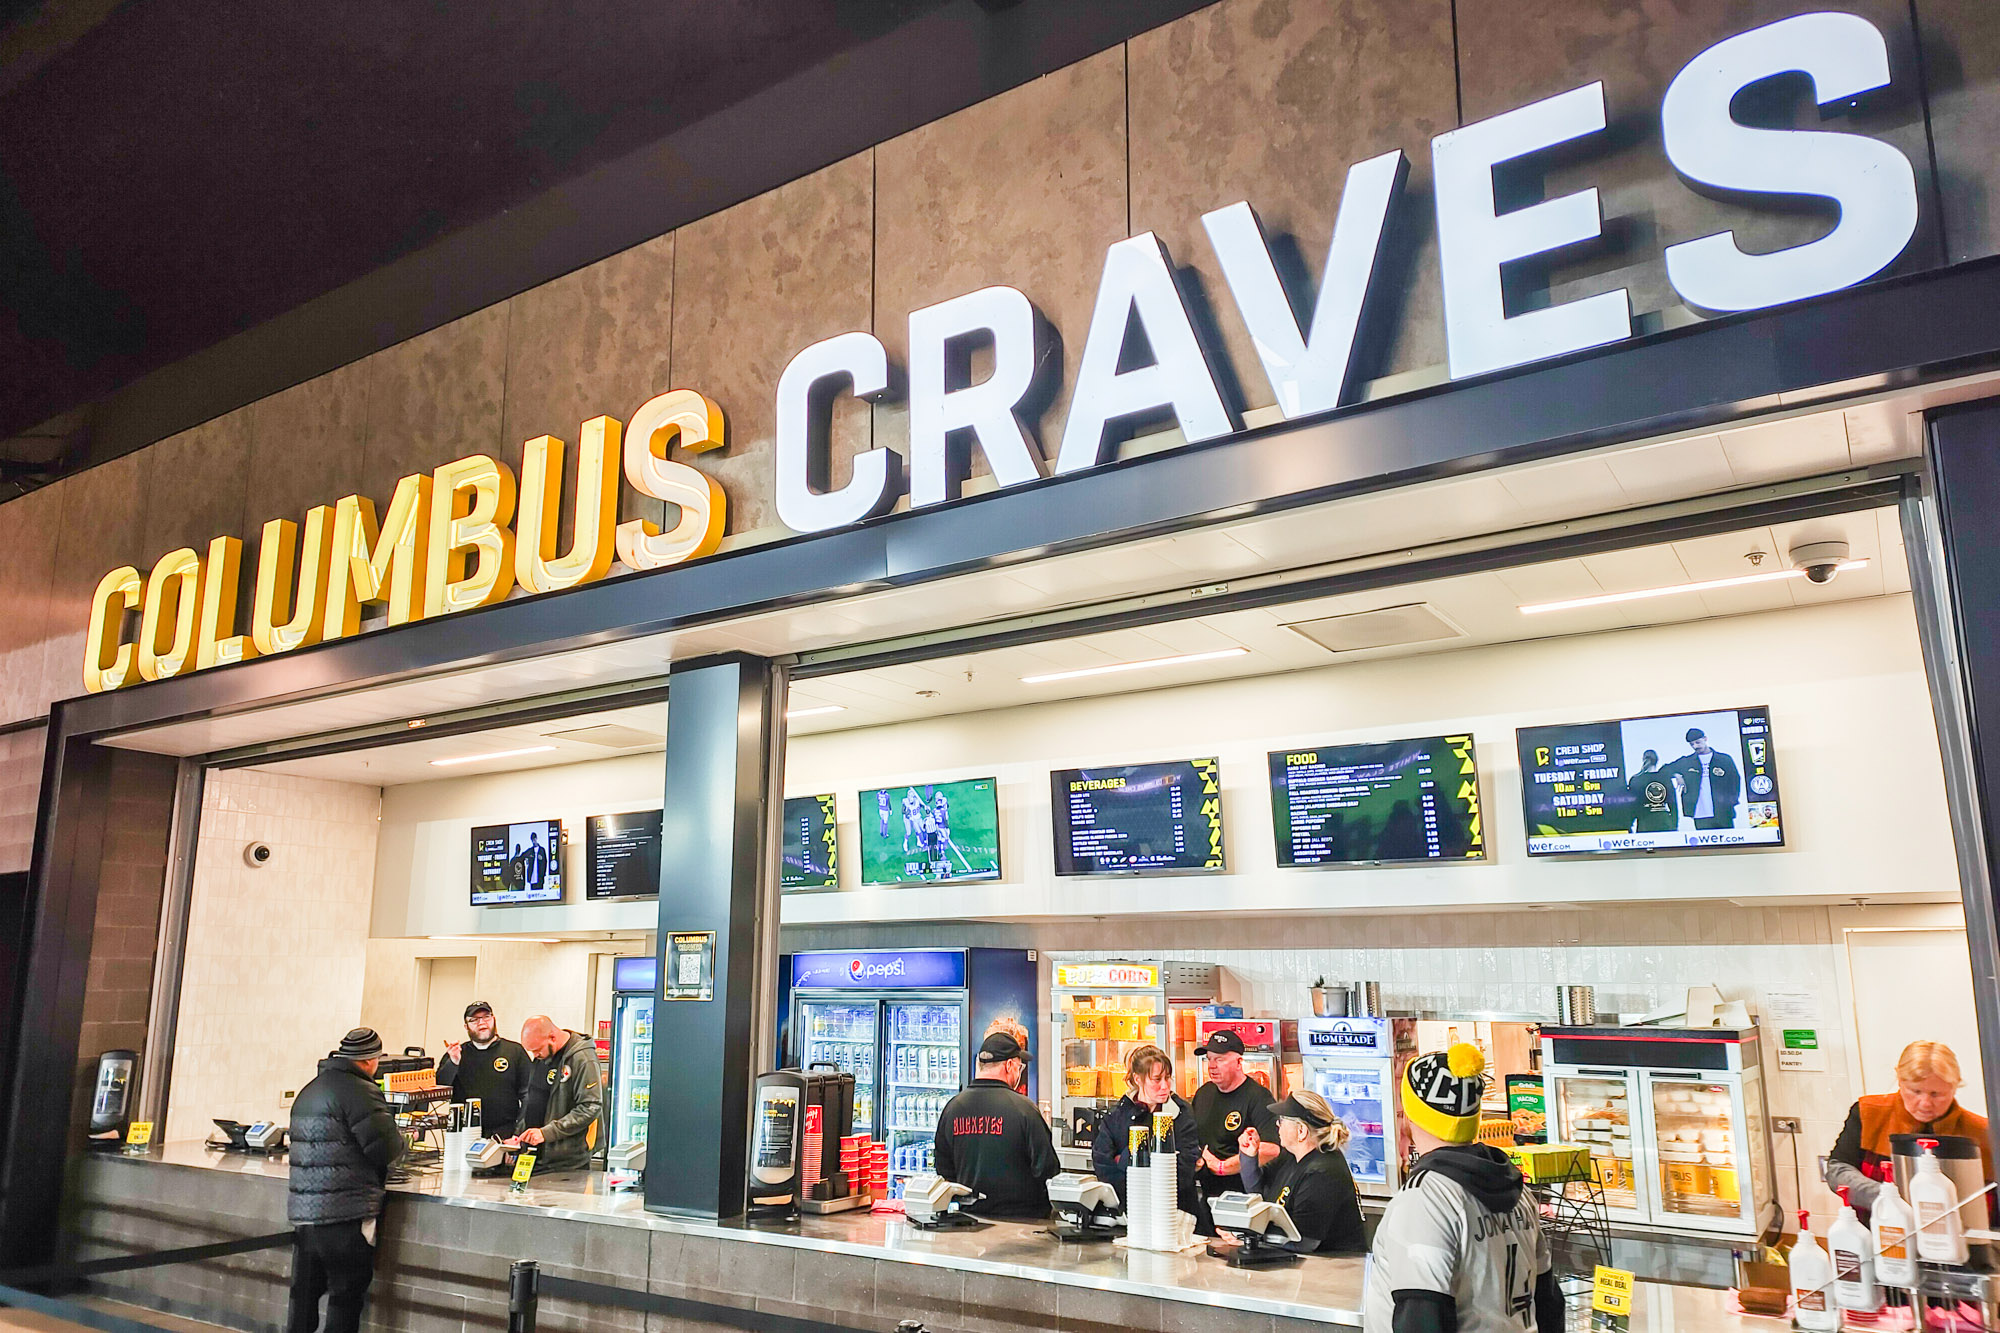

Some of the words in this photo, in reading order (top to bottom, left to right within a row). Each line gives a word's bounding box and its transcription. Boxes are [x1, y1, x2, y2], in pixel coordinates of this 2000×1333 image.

[83, 388, 727, 693] COLUMBUS
[774, 11, 1919, 534] CRAVES
[1555, 746, 1580, 756] CREW
[1581, 743, 1605, 754] SHOP
[1287, 752, 1318, 766] FOOD
[1534, 770, 1576, 784] TUESDAY
[1583, 767, 1619, 780] FRIDAY
[1070, 777, 1127, 792] BEVERAGES
[1554, 782, 1575, 793] 10AM
[1583, 780, 1601, 791] 6PM
[1553, 793, 1605, 807] SATURDAY
[1556, 807, 1577, 817] 11AM
[1585, 805, 1603, 816] 5PM
[1529, 843, 1571, 851] wer.com
[674, 935, 708, 944] COLUMBUS
[867, 959, 906, 979] pepsi
[1109, 968, 1149, 984] CORN
[1313, 1034, 1374, 1045] HOMEMADE
[1516, 1096, 1538, 1104] NACHO
[953, 1115, 1003, 1136] BUCKEYES
[1600, 1277, 1613, 1287] MEAL
[1614, 1280, 1627, 1290] DEAL
